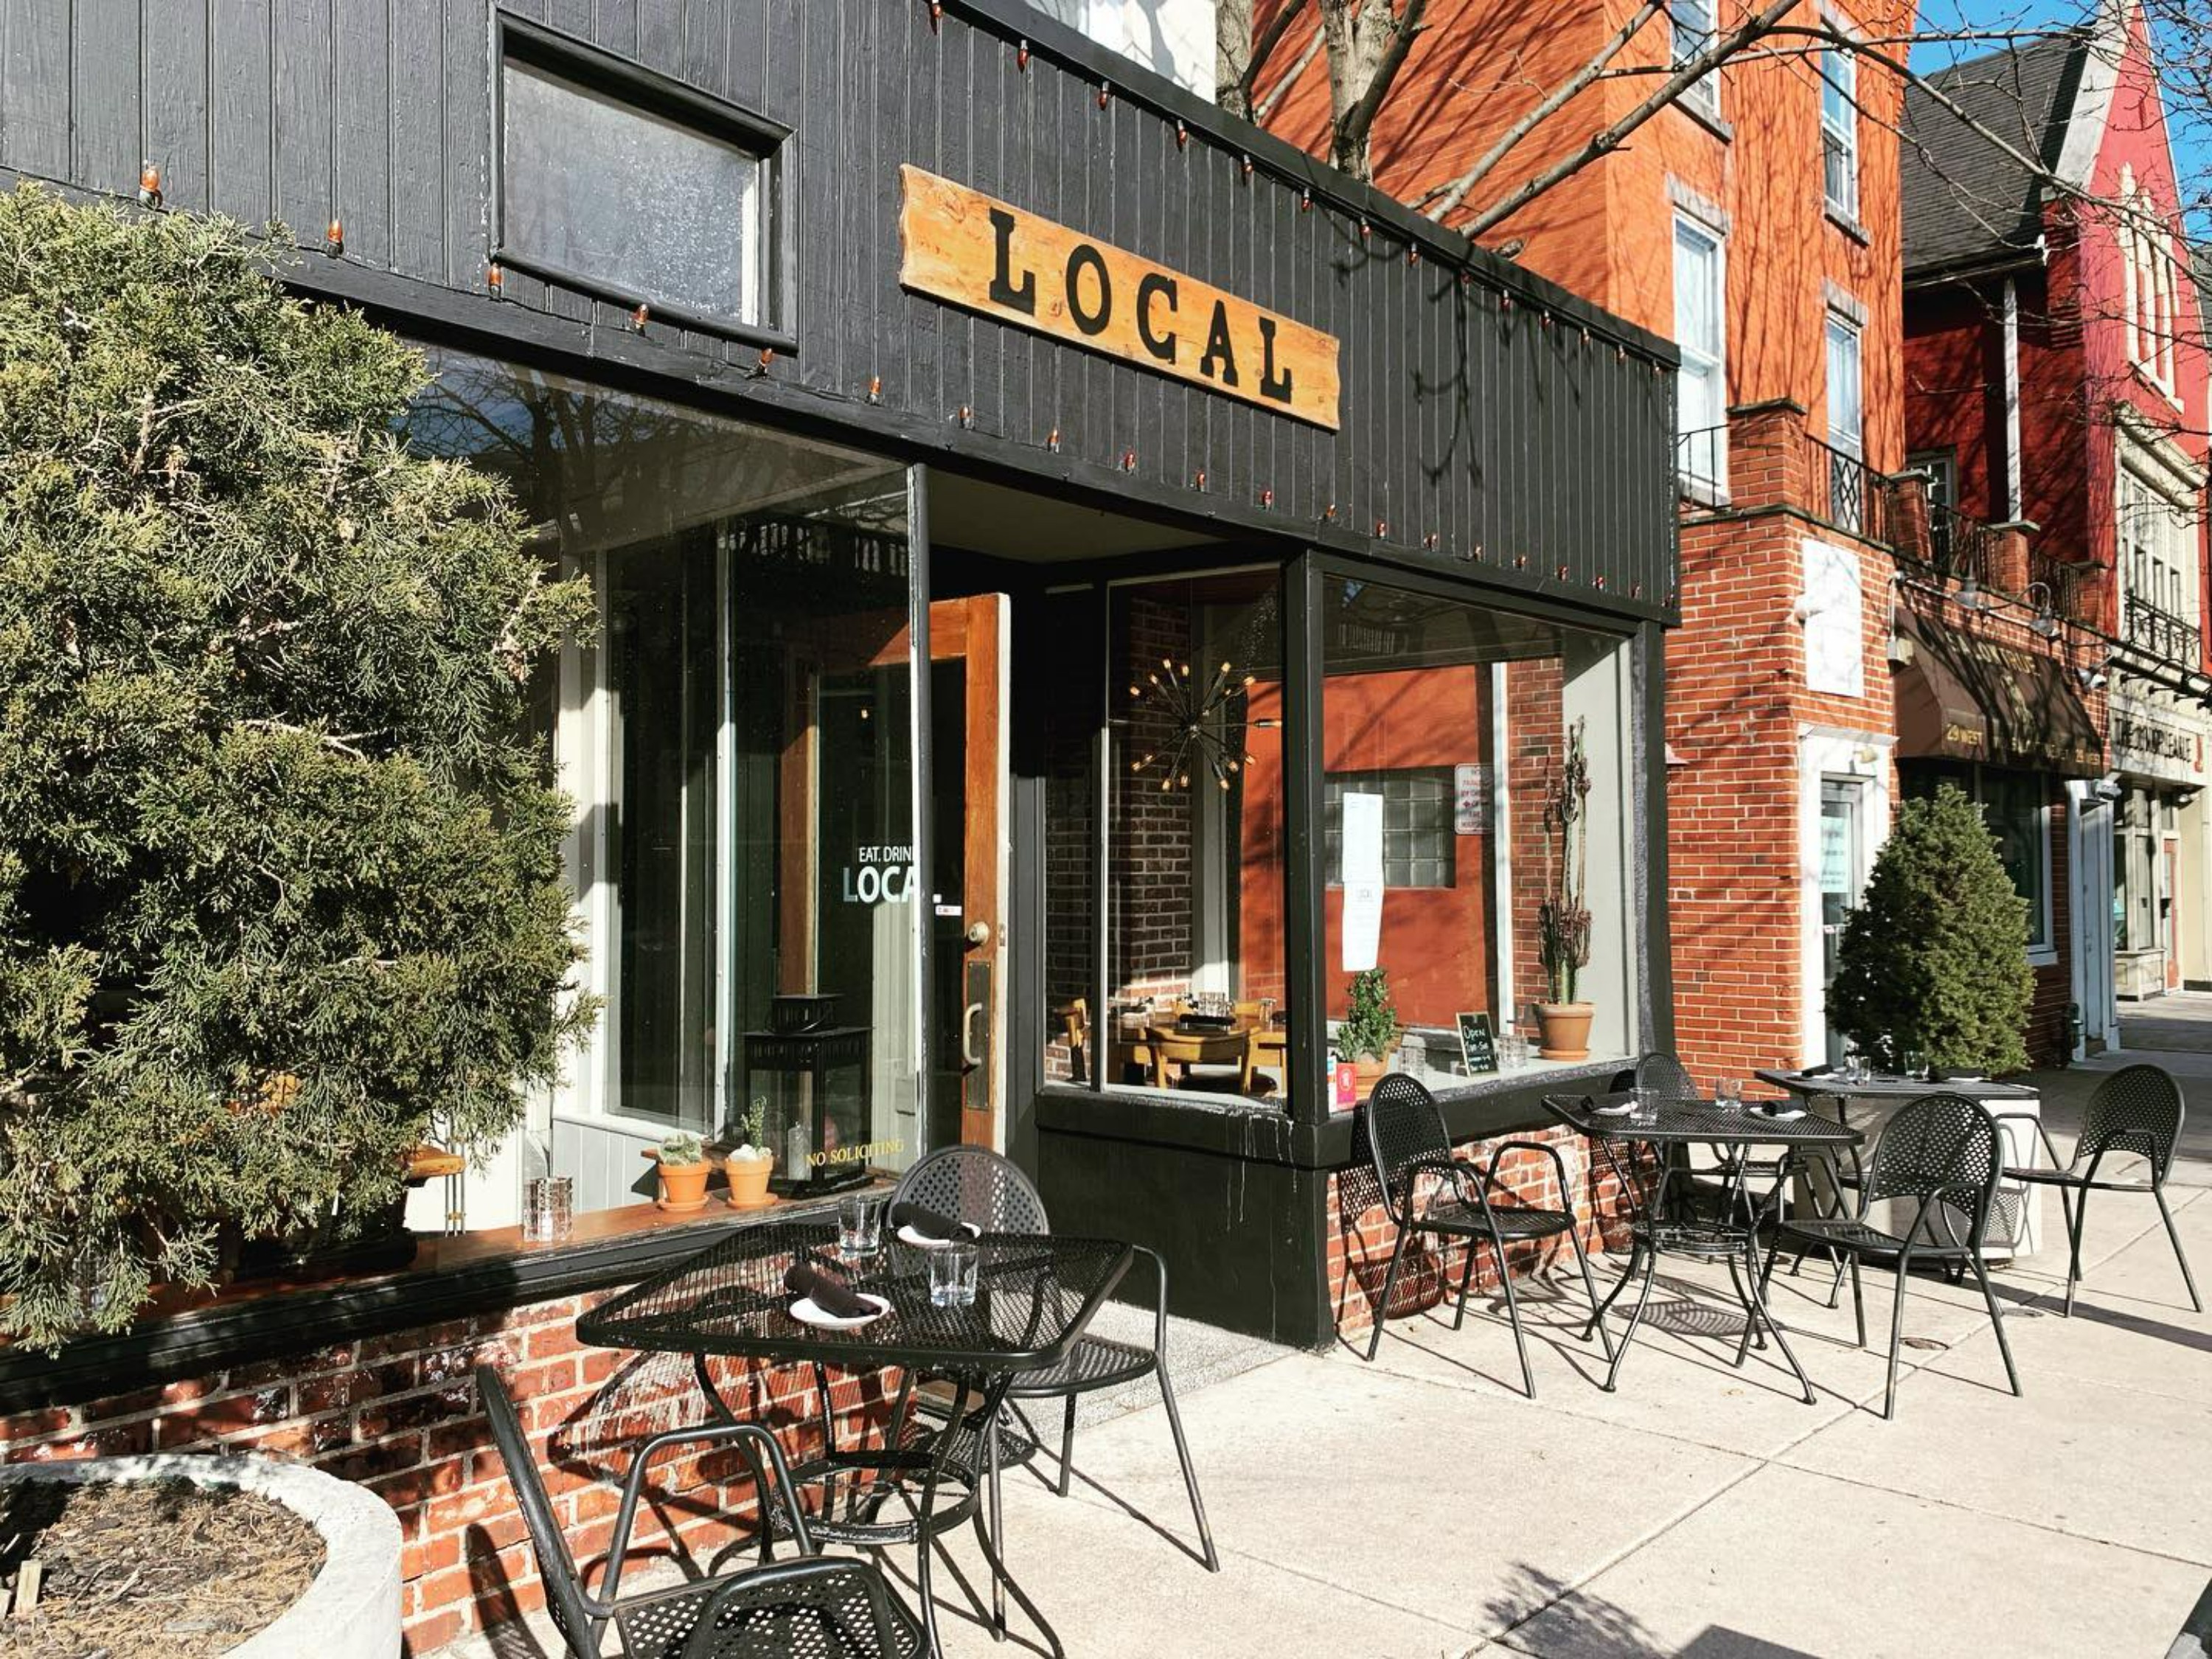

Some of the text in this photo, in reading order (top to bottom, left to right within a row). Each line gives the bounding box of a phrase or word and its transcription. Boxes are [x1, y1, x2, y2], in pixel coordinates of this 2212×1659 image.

[990, 207, 1292, 404] LOCAL
[883, 846, 914, 863] DRIN
[805, 1138, 904, 1168] NO SOLICITING
